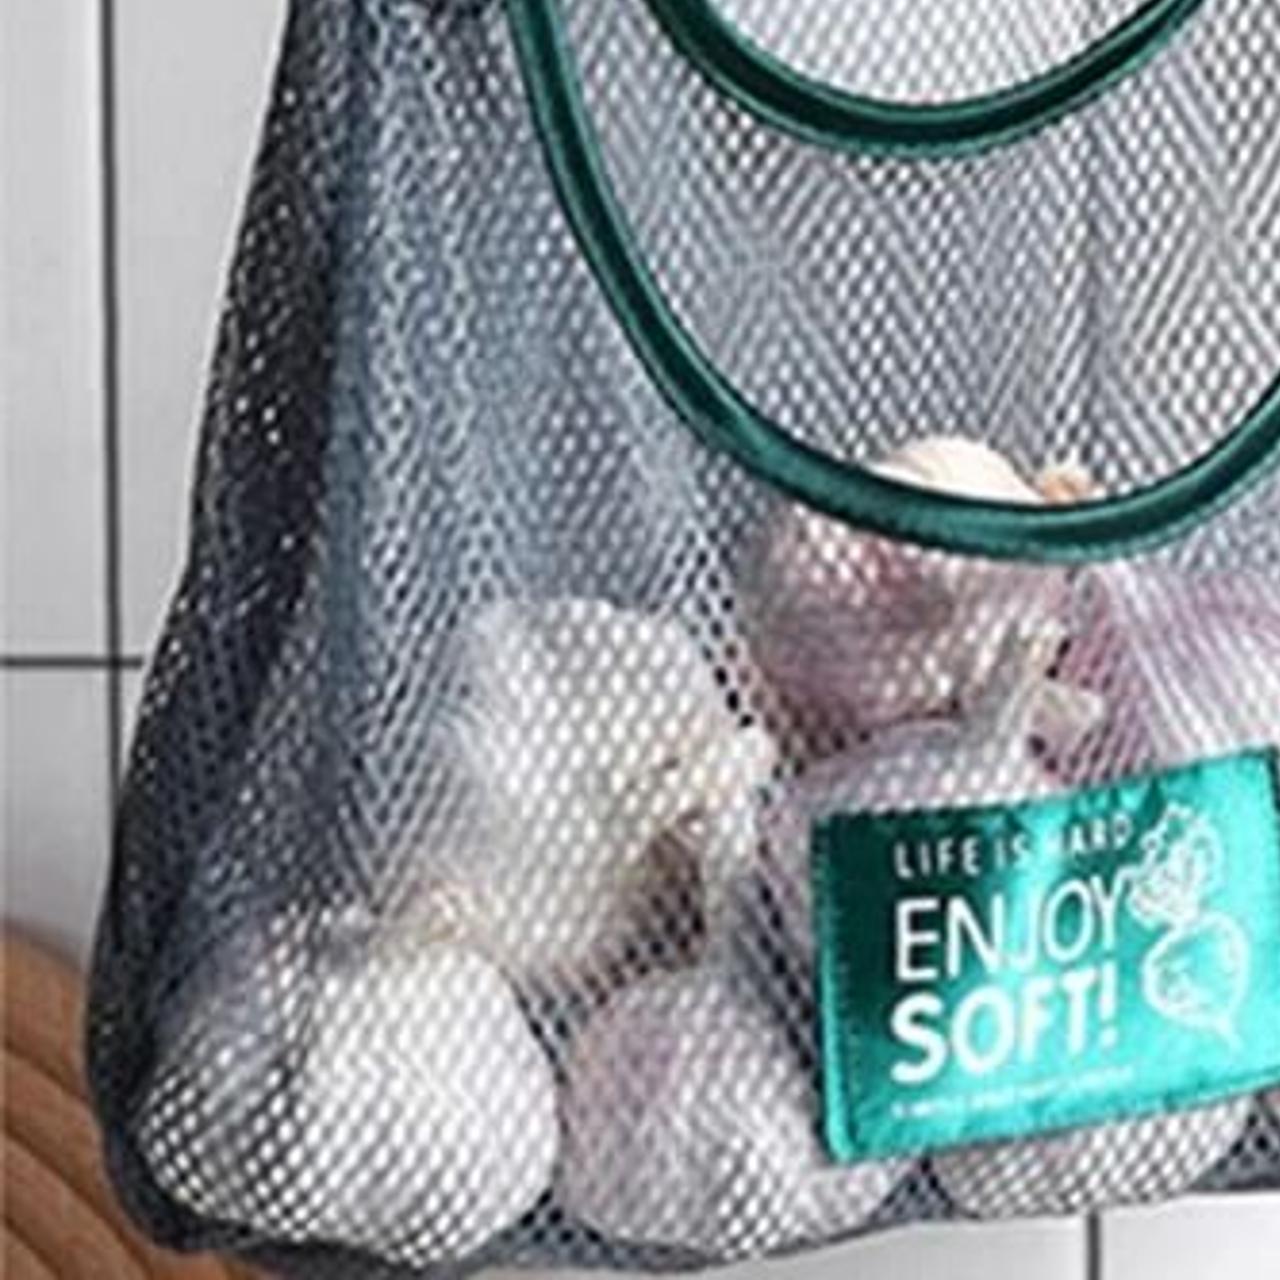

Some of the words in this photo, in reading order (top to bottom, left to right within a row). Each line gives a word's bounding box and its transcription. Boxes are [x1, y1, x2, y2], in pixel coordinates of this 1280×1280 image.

[894, 837, 980, 878] LIFE
[997, 833, 1034, 868] IS
[895, 874, 1126, 982] ENJOY
[890, 961, 1119, 1083] SOFT!
